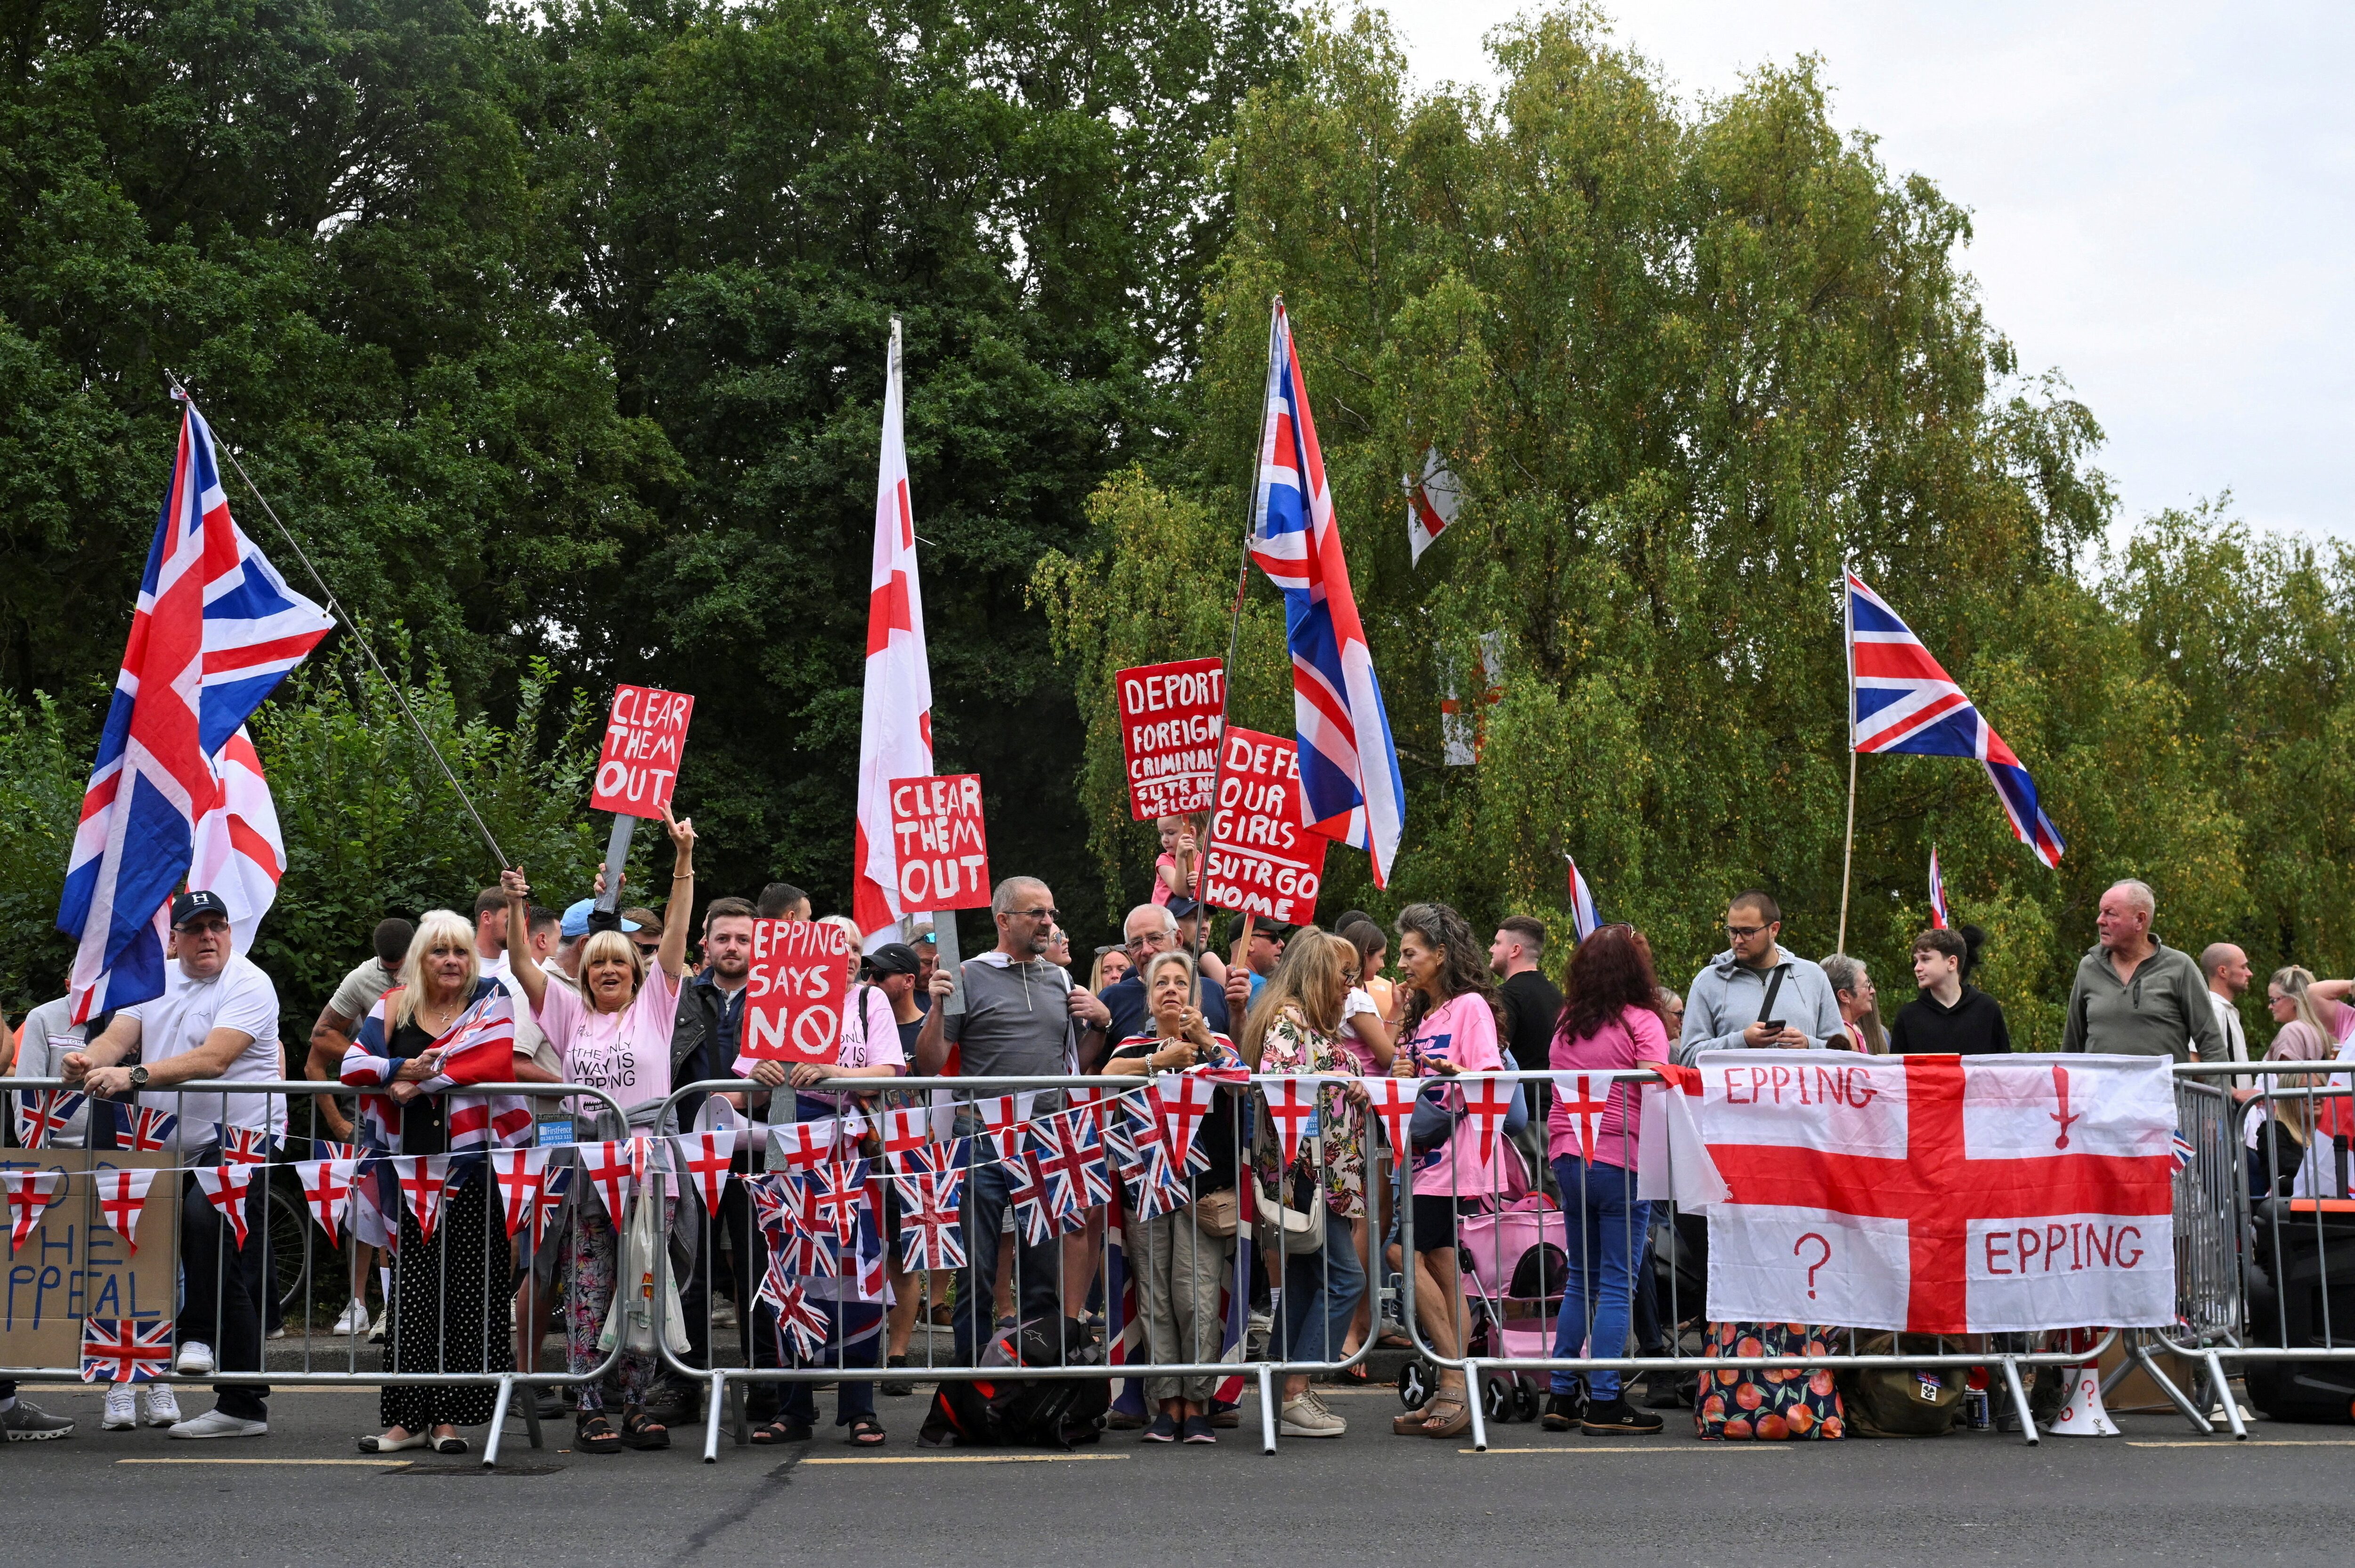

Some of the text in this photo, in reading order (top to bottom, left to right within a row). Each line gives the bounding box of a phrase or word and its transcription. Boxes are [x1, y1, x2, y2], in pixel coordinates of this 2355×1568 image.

[613, 689, 688, 732] CLEAR
[1125, 669, 1223, 715] DEPORT
[609, 725, 675, 765] THEM
[1133, 715, 1222, 753] FOREIGN
[1226, 737, 1299, 780] DEFE
[596, 761, 674, 805] OUT
[893, 777, 980, 818] CLEAR
[1137, 780, 1190, 801] SUTR
[1220, 777, 1286, 817] OUR
[1141, 792, 1211, 818] WELCOM
[895, 816, 983, 855] THEM
[1212, 810, 1295, 850] GIRLS
[192, 894, 209, 903] H
[901, 855, 984, 902] OUT
[1206, 879, 1294, 922] HOME
[754, 921, 849, 960] EPPING
[748, 964, 830, 999] SAYS
[748, 1005, 838, 1055] NO
[573, 1048, 634, 1075] WAY IS
[853, 1047, 865, 1063] IS
[1724, 1065, 1877, 1109] EPPING
[547, 1126, 572, 1135] FirstFence
[0, 1224, 122, 1266] THE
[1985, 1222, 2144, 1275] EPPING
